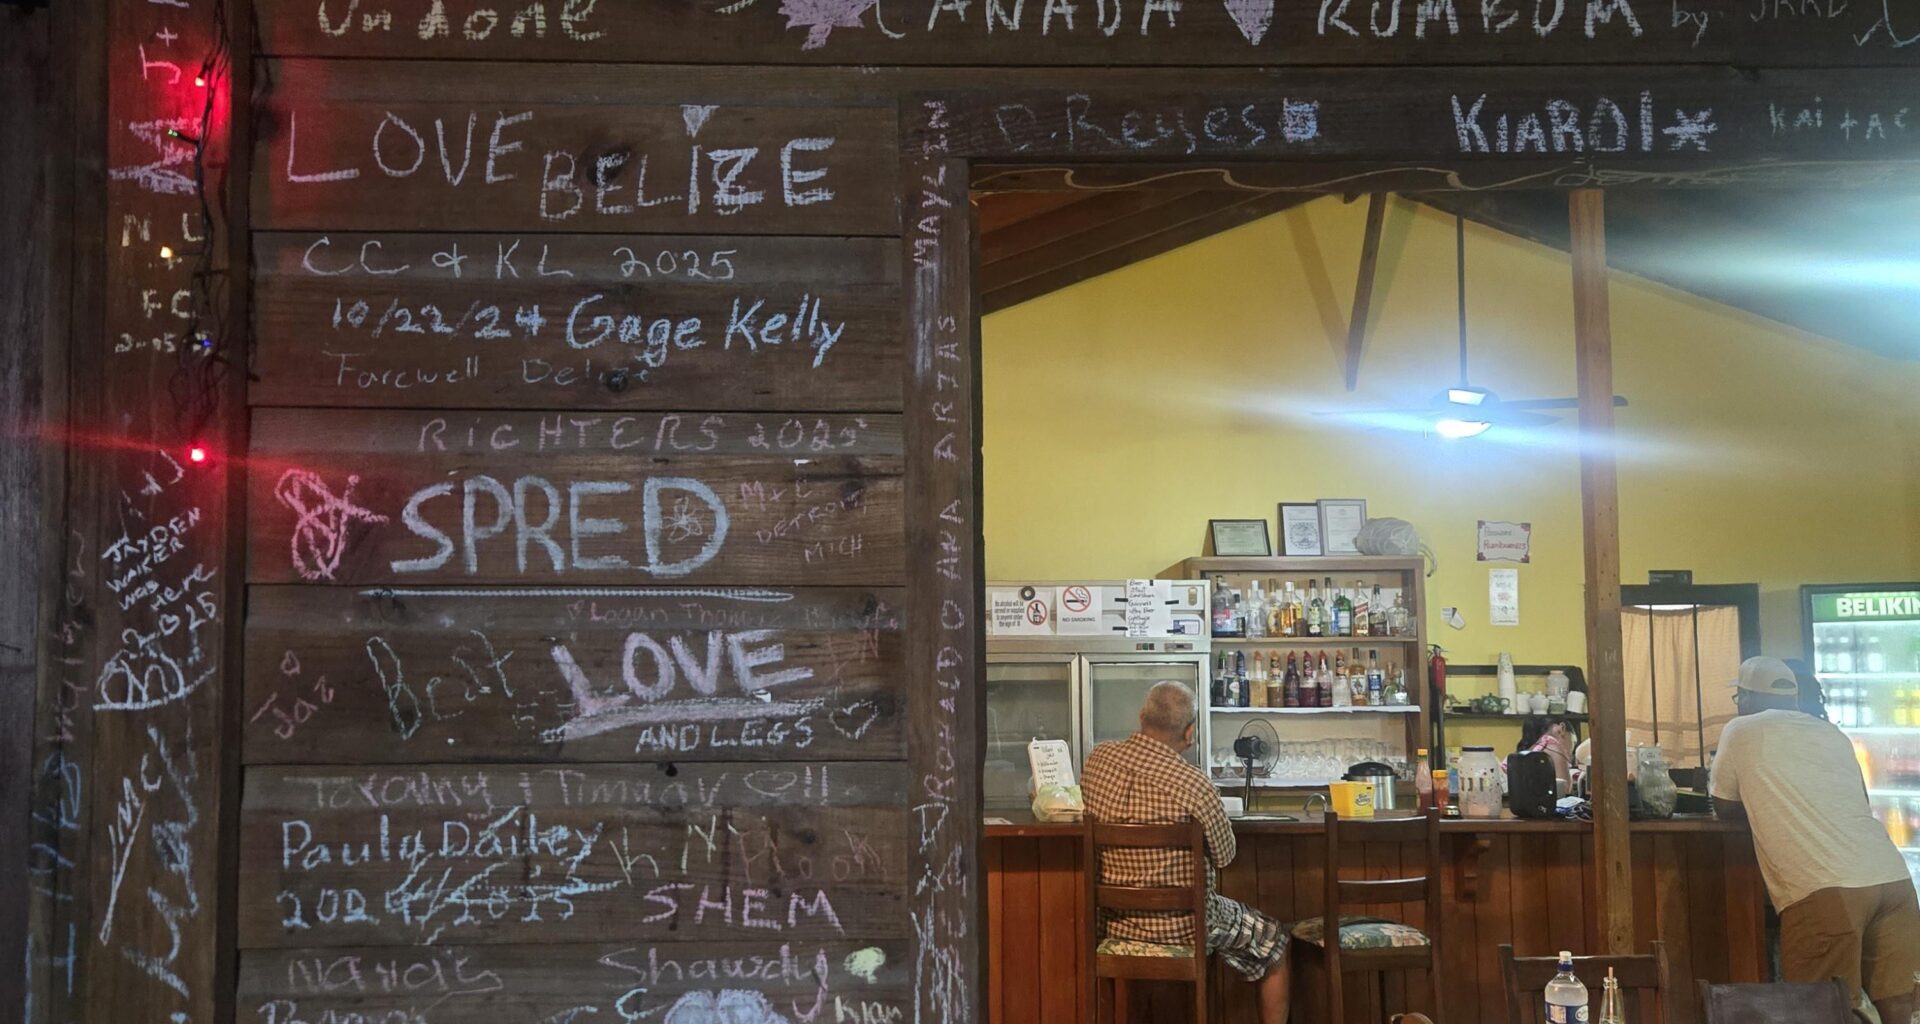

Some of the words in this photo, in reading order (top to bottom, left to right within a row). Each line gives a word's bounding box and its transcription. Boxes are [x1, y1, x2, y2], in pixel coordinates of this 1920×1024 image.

[287, 109, 533, 187] LOVE
[540, 106, 836, 221] BELIZE
[613, 246, 737, 280] 2025
[331, 297, 547, 341] 10/22/24
[724, 293, 846, 368] Kelly
[321, 349, 480, 390] Farewell
[391, 473, 730, 577] SPRED
[550, 628, 814, 718] LOVE
[635, 724, 700, 754] AND
[643, 884, 846, 935] SHEM
